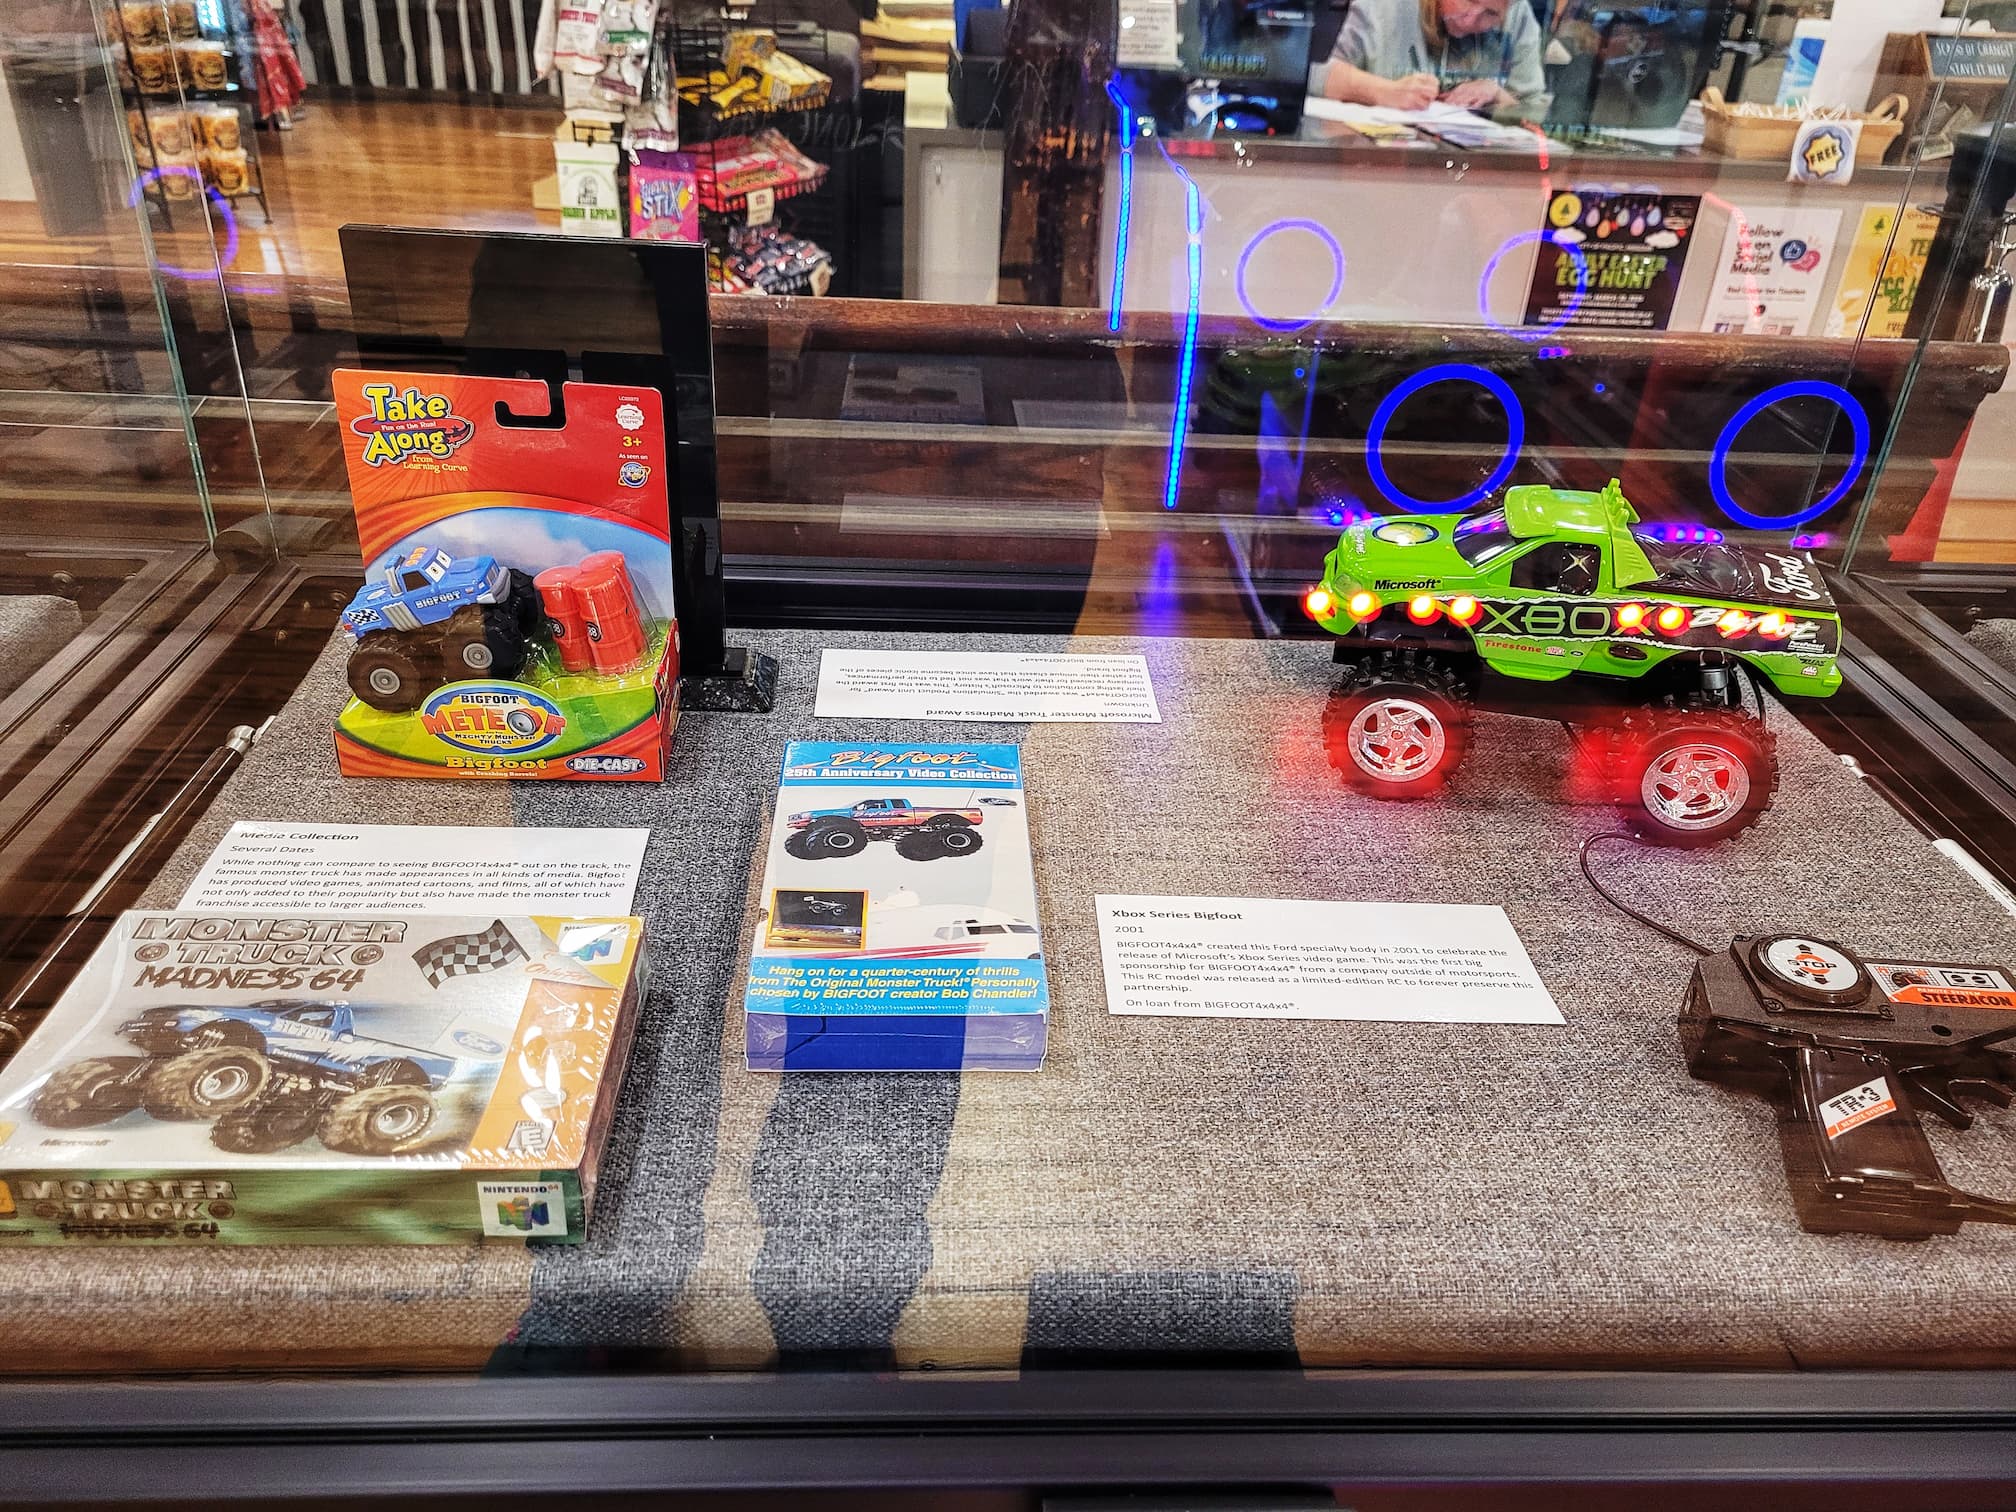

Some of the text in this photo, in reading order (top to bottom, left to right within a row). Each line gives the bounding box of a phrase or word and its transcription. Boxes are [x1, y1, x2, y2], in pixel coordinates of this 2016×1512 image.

[1809, 144, 1839, 166] FREE
[1599, 269, 1658, 289] HUNT
[366, 387, 448, 422] Take
[366, 430, 448, 462] Along
[623, 436, 642, 447] 3+
[412, 455, 433, 463] from
[403, 462, 469, 473] Learning Curve
[1759, 552, 1821, 601] Ford
[415, 590, 461, 609] BIGFOOT
[1478, 603, 1655, 637] XBOX
[1689, 607, 1821, 641] Bgfot
[1484, 640, 1542, 653] Firestone
[460, 694, 519, 704] BIGFOOT
[422, 708, 567, 736] METEOR
[445, 756, 548, 770] Bigfoot
[572, 756, 641, 772] DIE-CAST
[831, 750, 978, 769] Bigfoot
[785, 768, 1017, 780] 25th Anniversary Video Collection
[230, 845, 315, 854] Several Dates
[222, 859, 255, 867] While
[257, 860, 300, 868] nothing
[326, 861, 375, 869] compare
[392, 861, 428, 869] seeing
[581, 862, 610, 870] track,
[196, 899, 250, 907] franchise
[252, 900, 311, 908] accessible
[330, 901, 364, 909] larger
[366, 901, 427, 909] audiences.
[1112, 910, 1243, 921] Xbox Series Bigfoot
[132, 918, 408, 943] MONSTER
[176, 943, 349, 966] TRUCK
[1206, 942, 1248, 951] created
[1250, 943, 1271, 951] this
[1273, 944, 1298, 952] Ford
[1300, 944, 1347, 954] specialty
[1350, 945, 1377, 954] body
[1379, 945, 1390, 953] in
[1393, 946, 1419, 954] 2001
[1436, 948, 1486, 956] celebrate
[1489, 949, 1508, 957] the
[1267, 954, 1301, 962] Series
[1303, 954, 1333, 963] video
[1336, 957, 1369, 965] game.
[1371, 956, 1394, 965] This
[1420, 958, 1440, 966] the
[1441, 958, 1464, 966] first
[1466, 959, 1483, 968] big
[1787, 959, 1837, 970] STOP
[134, 965, 367, 992] MADNESS 64
[768, 966, 1021, 978] Hang on for a quarter-century of thrills
[749, 976, 781, 986] from
[783, 977, 807, 987] The
[810, 977, 863, 989] Original
[866, 978, 921, 987] Monster
[971, 978, 1040, 989] Personally
[1123, 984, 1192, 993] partnership.
[749, 987, 1038, 1001] chosen by BIGFOOT creator Bob Chandler!
[1922, 993, 2013, 1007] STEERACON
[1126, 999, 1142, 1007] On
[1145, 999, 1171, 1008] loan
[1173, 1000, 1201, 1008] from
[1828, 1086, 1881, 1117] TR-3
[1840, 1103, 1889, 1128] REMOTE SYSTEM
[18, 1179, 238, 1200] MONSTER
[483, 1186, 548, 1194] NINTENDO
[63, 1201, 208, 1221] TRUCK
